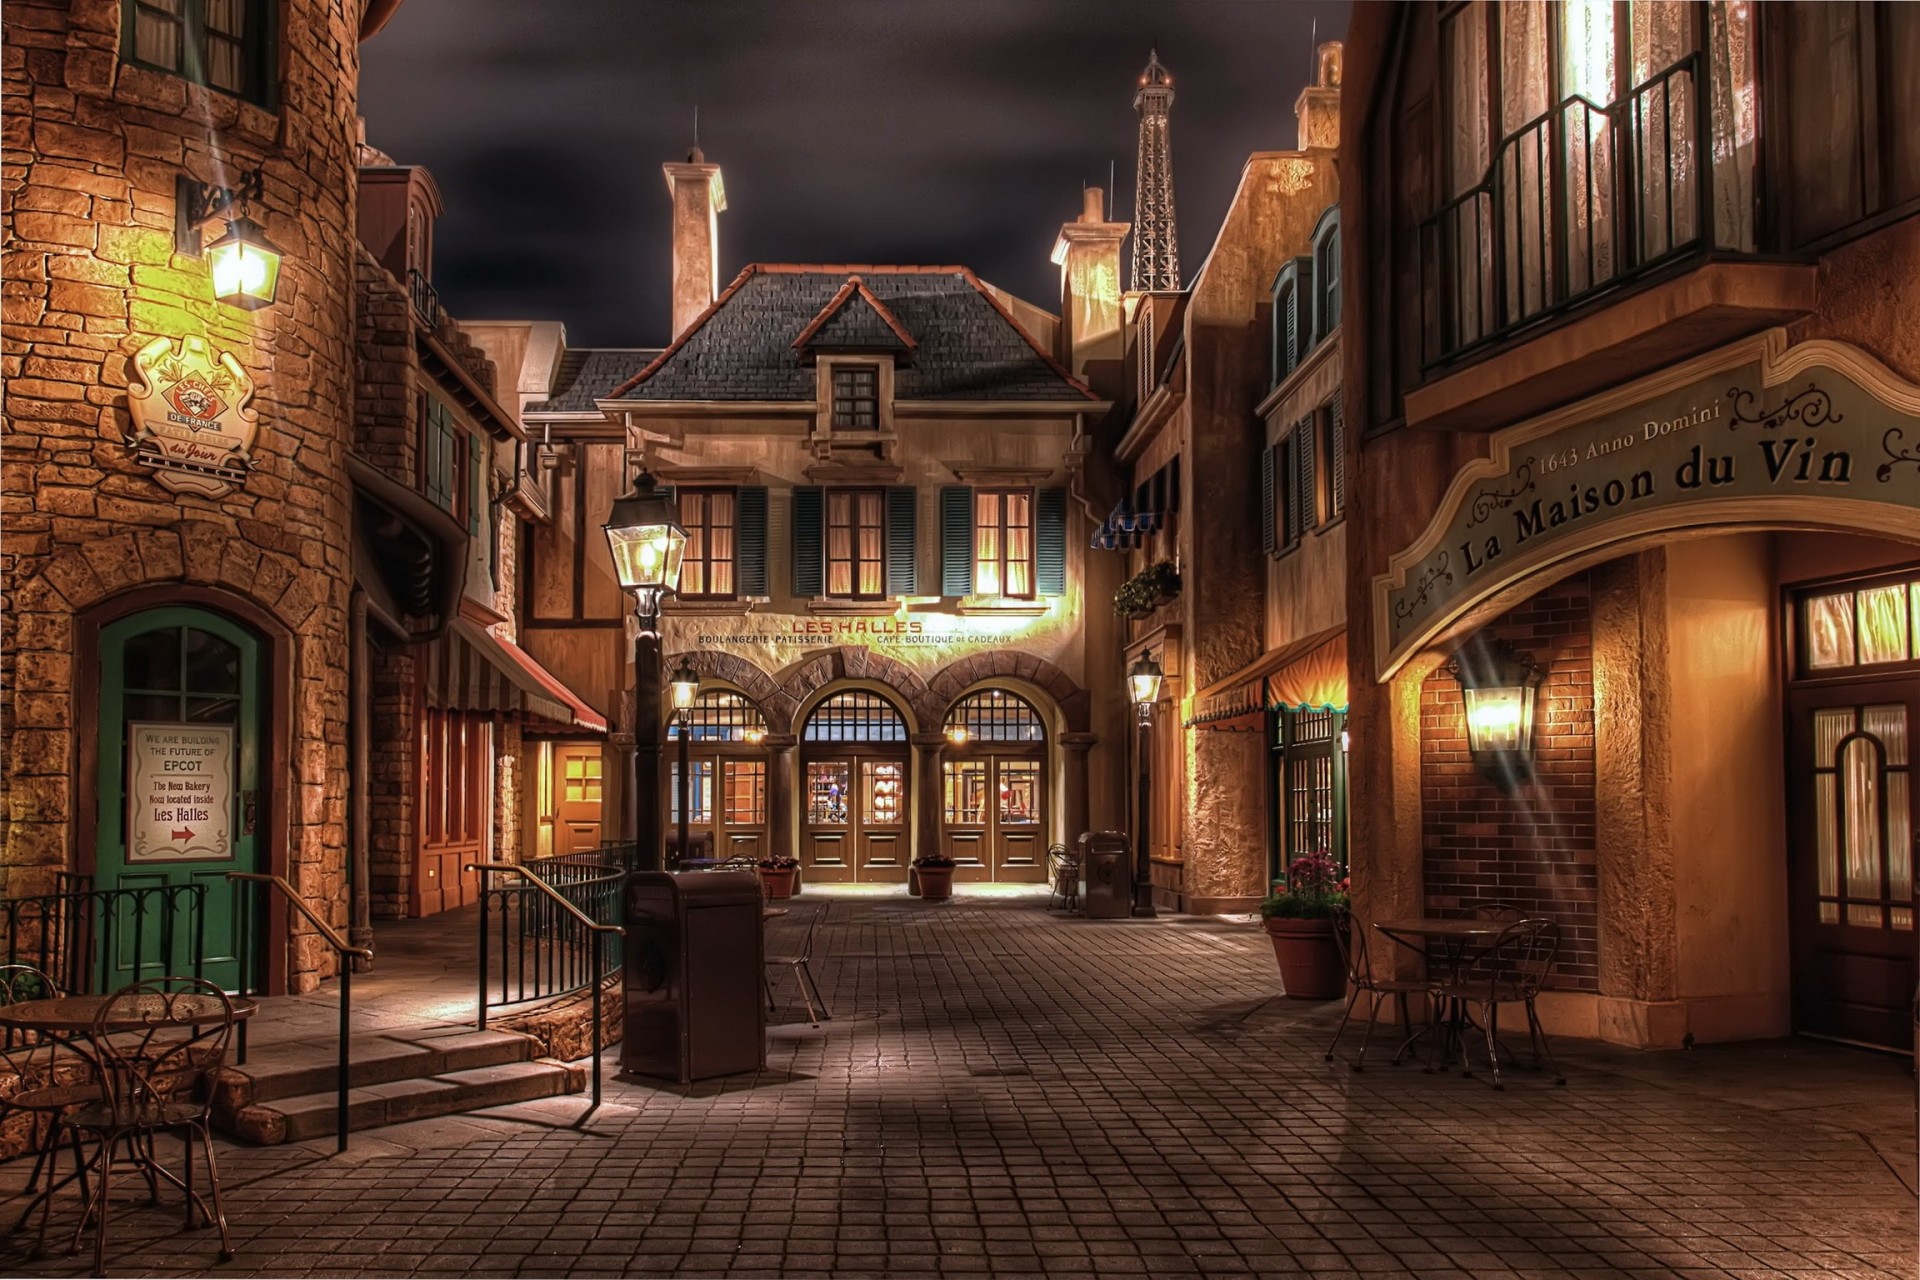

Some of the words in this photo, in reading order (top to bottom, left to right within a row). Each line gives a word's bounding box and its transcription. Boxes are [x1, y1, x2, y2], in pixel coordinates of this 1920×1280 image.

[175, 380, 191, 394] LES
[170, 412, 183, 422] DE
[185, 415, 219, 430] FRANCE
[1540, 447, 1578, 475] 1643
[1586, 433, 1634, 461] Anno
[1644, 399, 1721, 441] Domini
[170, 442, 187, 455] du
[148, 456, 236, 479] FRANCE
[1461, 533, 1502, 576] La
[1514, 469, 1655, 544] Maison
[1675, 444, 1736, 490] du
[1758, 436, 1852, 484] Vin
[792, 621, 832, 634] LES
[839, 621, 923, 634] HALLES
[698, 635, 769, 644] BOULANGERIE
[775, 635, 834, 644] PATISSERIE
[905, 635, 954, 645] BOUTIQUE
[968, 635, 1012, 644] CADEAUX
[145, 734, 160, 744] WE
[163, 736, 179, 744] ARE
[182, 737, 220, 745] BUILDING
[150, 747, 166, 756] THE
[169, 747, 202, 756] FUTURE
[204, 748, 216, 757] OF
[164, 760, 202, 771] EPCOT
[153, 781, 166, 791] The
[168, 781, 183, 791] New
[185, 781, 211, 793] Bakery
[149, 794, 165, 805] Now
[166, 794, 191, 804] located
[193, 794, 214, 804] inside
[154, 807, 173, 822] Les
[176, 807, 209, 823] Halles
